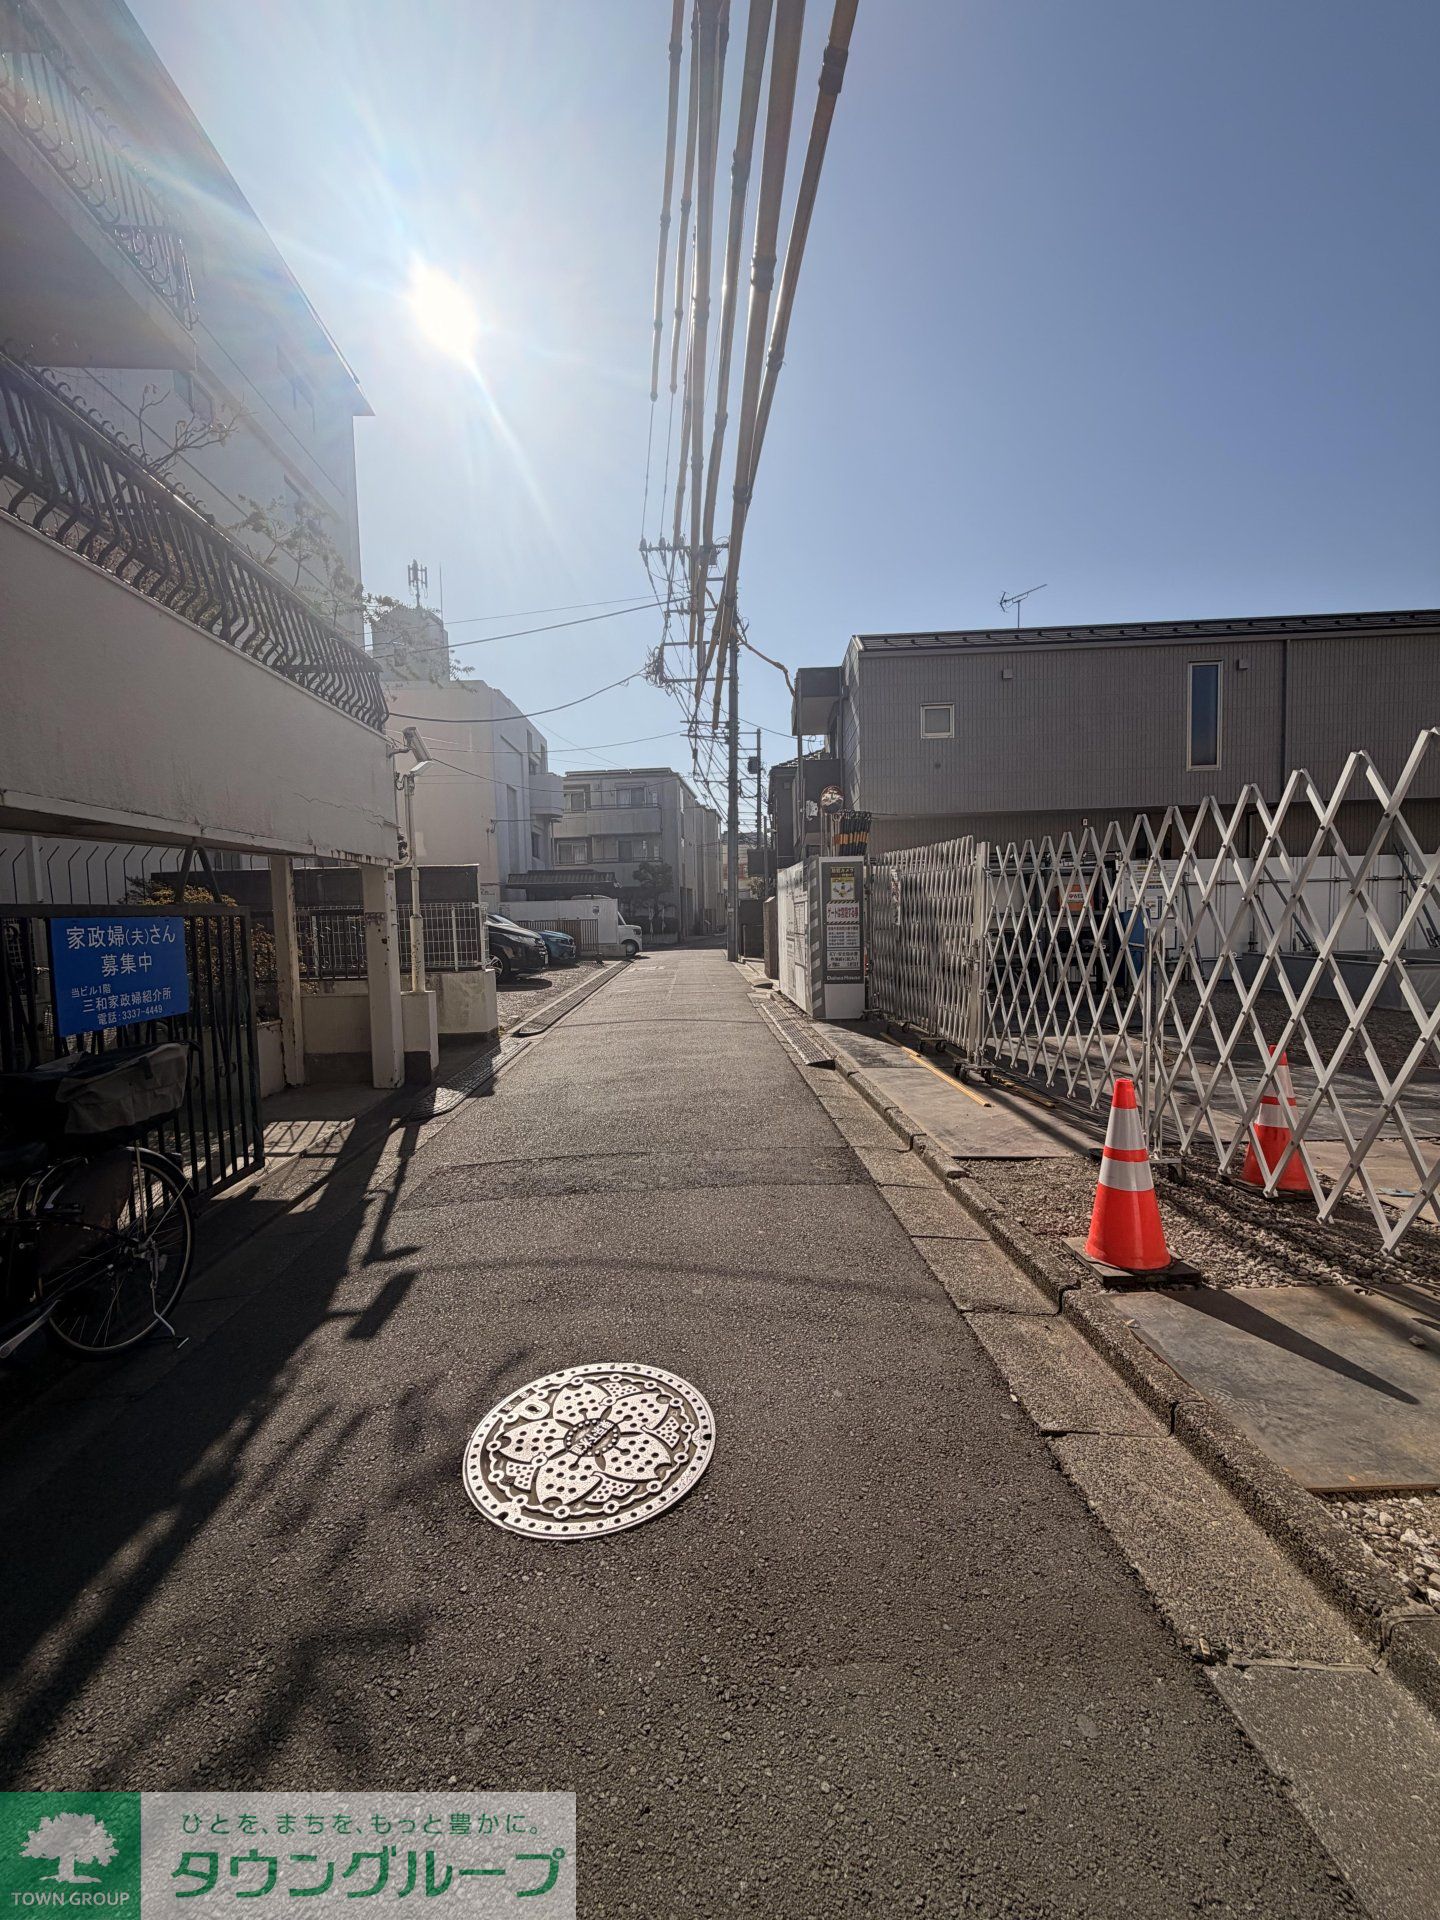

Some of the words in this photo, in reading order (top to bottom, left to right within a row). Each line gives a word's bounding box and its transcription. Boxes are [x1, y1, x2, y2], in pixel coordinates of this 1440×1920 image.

[66, 924, 176, 950] 家政婦(夫)さん
[101, 952, 153, 977] 募集中
[71, 984, 112, 998] 当ビル1階
[82, 987, 172, 1013] 三和家政婦紹介所
